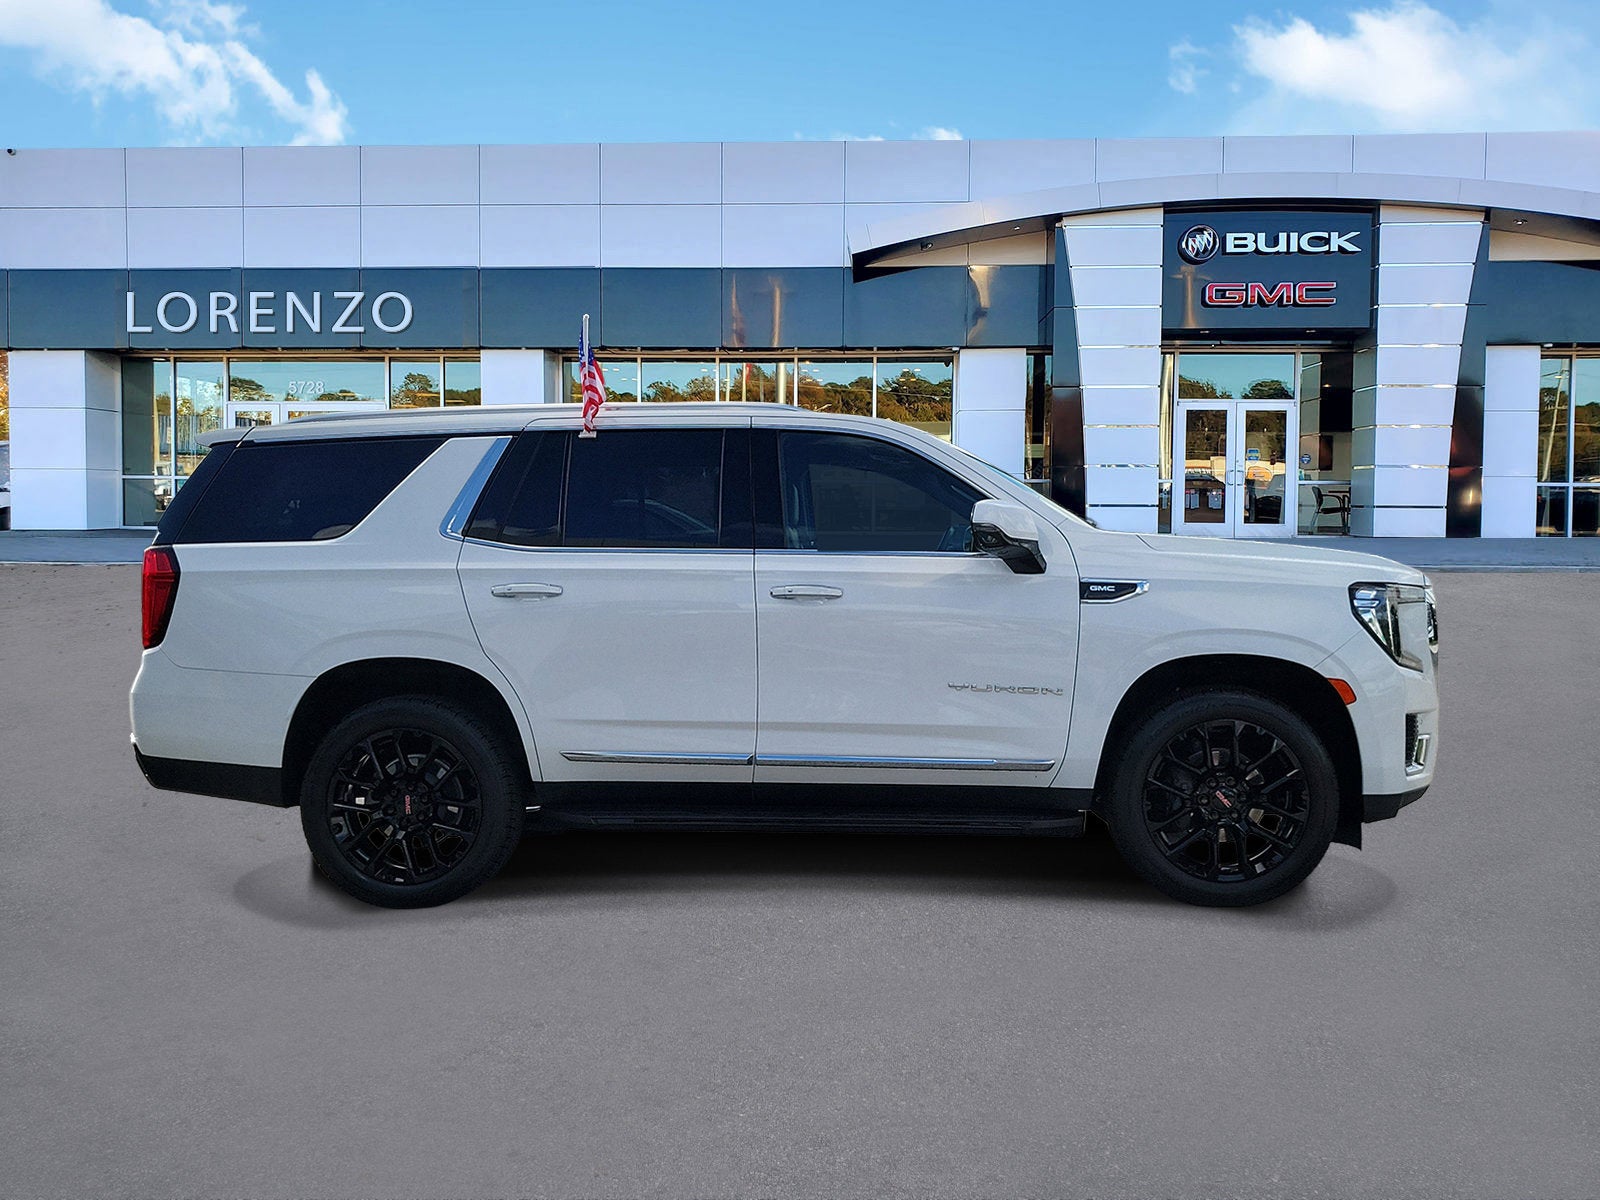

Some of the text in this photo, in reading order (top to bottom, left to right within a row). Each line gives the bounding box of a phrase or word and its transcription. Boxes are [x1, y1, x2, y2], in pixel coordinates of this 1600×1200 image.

[1226, 231, 1362, 253] BUICK
[1205, 282, 1336, 305] GMC
[126, 291, 413, 334] LORENZO
[288, 381, 324, 394] 5728
[948, 683, 1063, 696] YUKON
[404, 794, 412, 815] GMC
